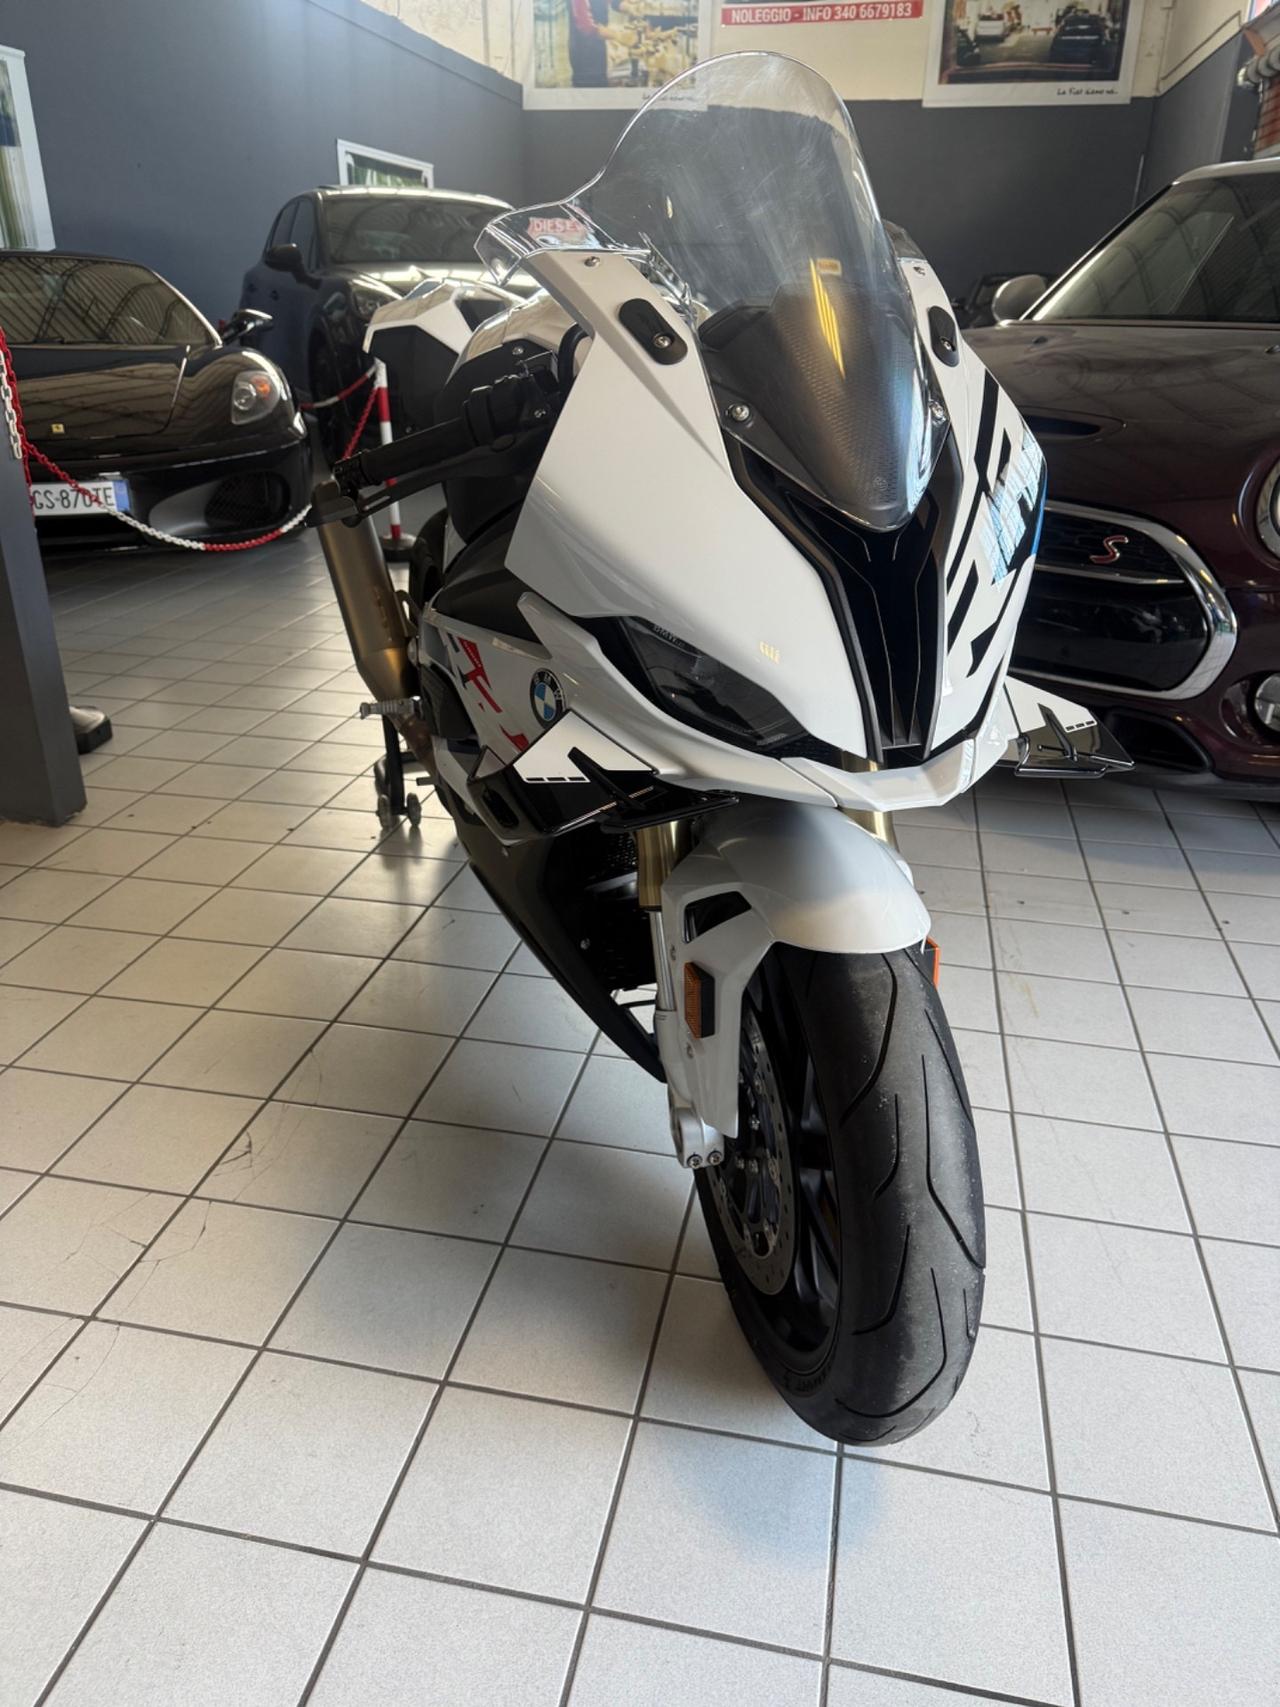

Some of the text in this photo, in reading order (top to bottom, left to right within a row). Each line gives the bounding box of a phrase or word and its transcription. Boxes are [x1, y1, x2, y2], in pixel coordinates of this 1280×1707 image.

[731, 8, 791, 24] NOLEGGIO
[802, 7, 831, 21] INFO
[834, 6, 856, 20] 340
[859, 2, 912, 18] 6679183
[1090, 534, 1129, 564] S
